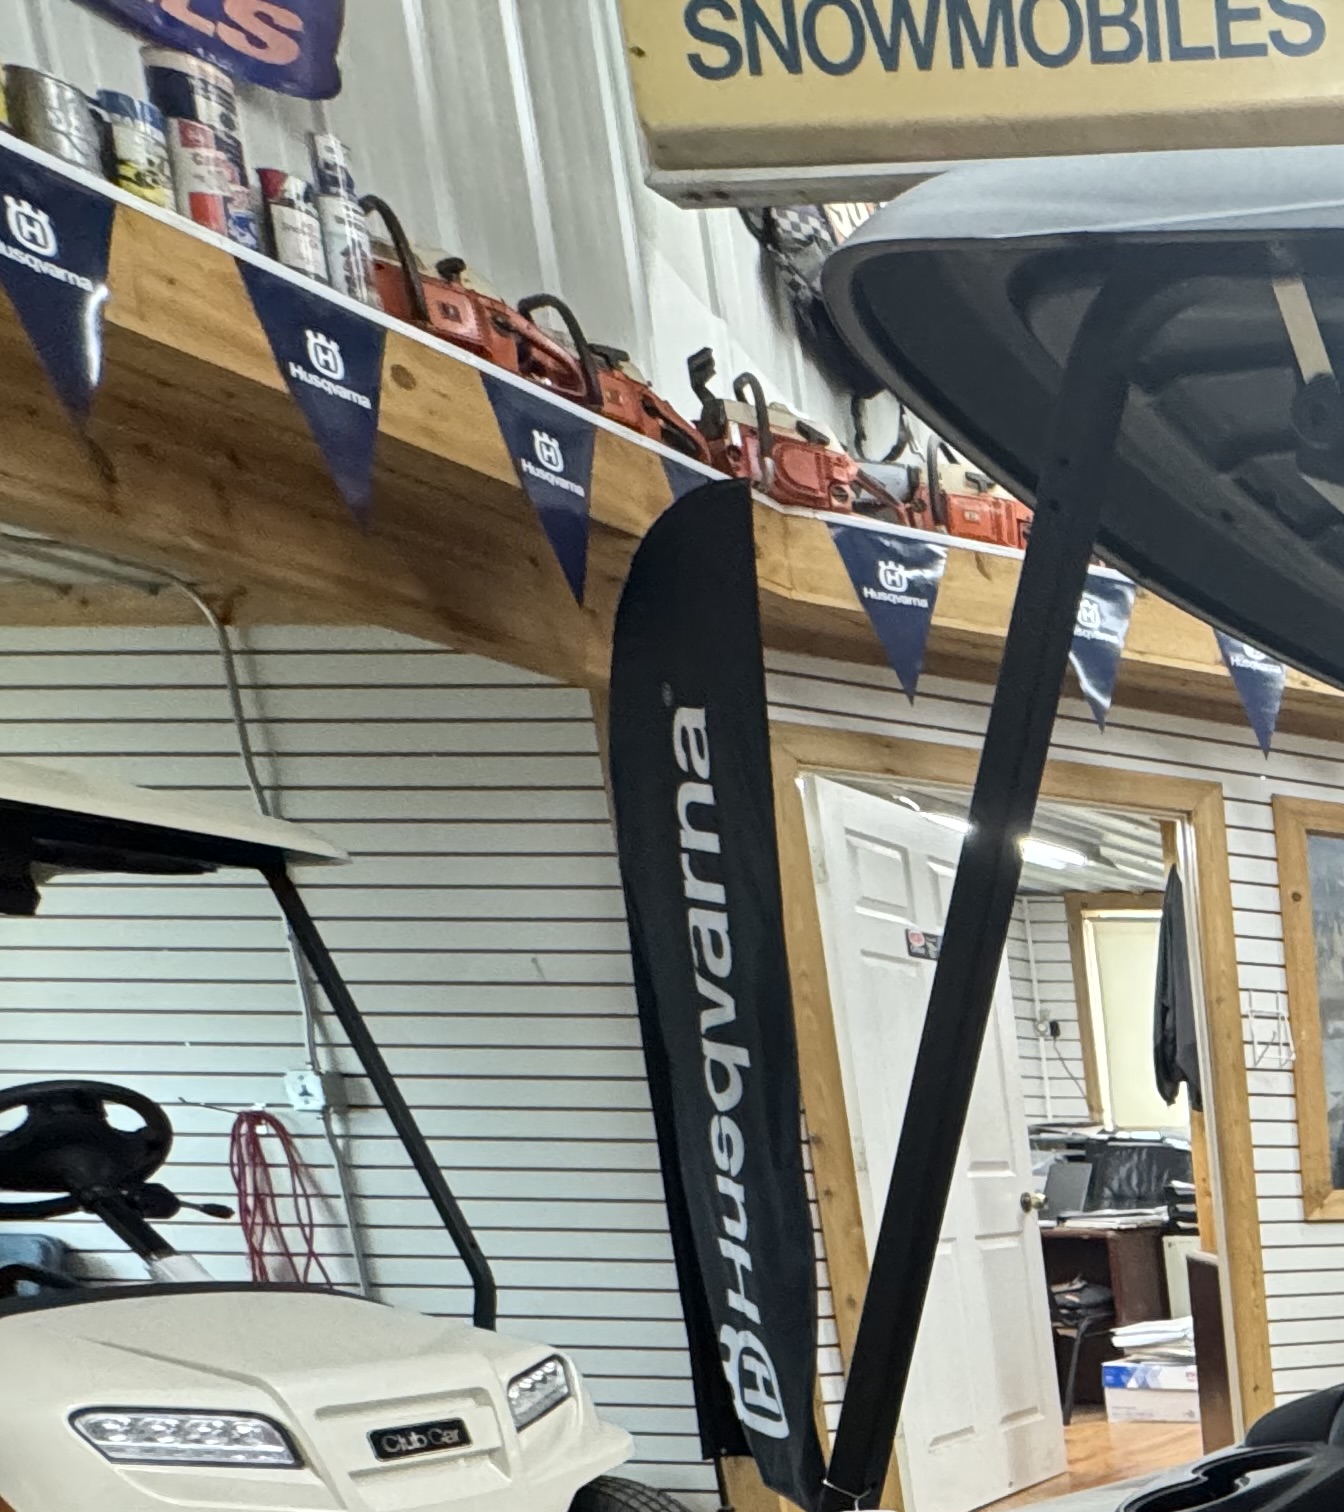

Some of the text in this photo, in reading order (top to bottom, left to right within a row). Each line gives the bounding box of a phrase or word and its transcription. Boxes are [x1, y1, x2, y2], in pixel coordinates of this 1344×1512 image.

[684, 0, 1326, 81] SNOWMOBILES
[288, 361, 372, 410] Husqvarna
[520, 457, 586, 498] Husqvarna
[862, 587, 929, 608] Husqvarna
[672, 704, 763, 1324] Husqvarna
[381, 1431, 427, 1453] Club
